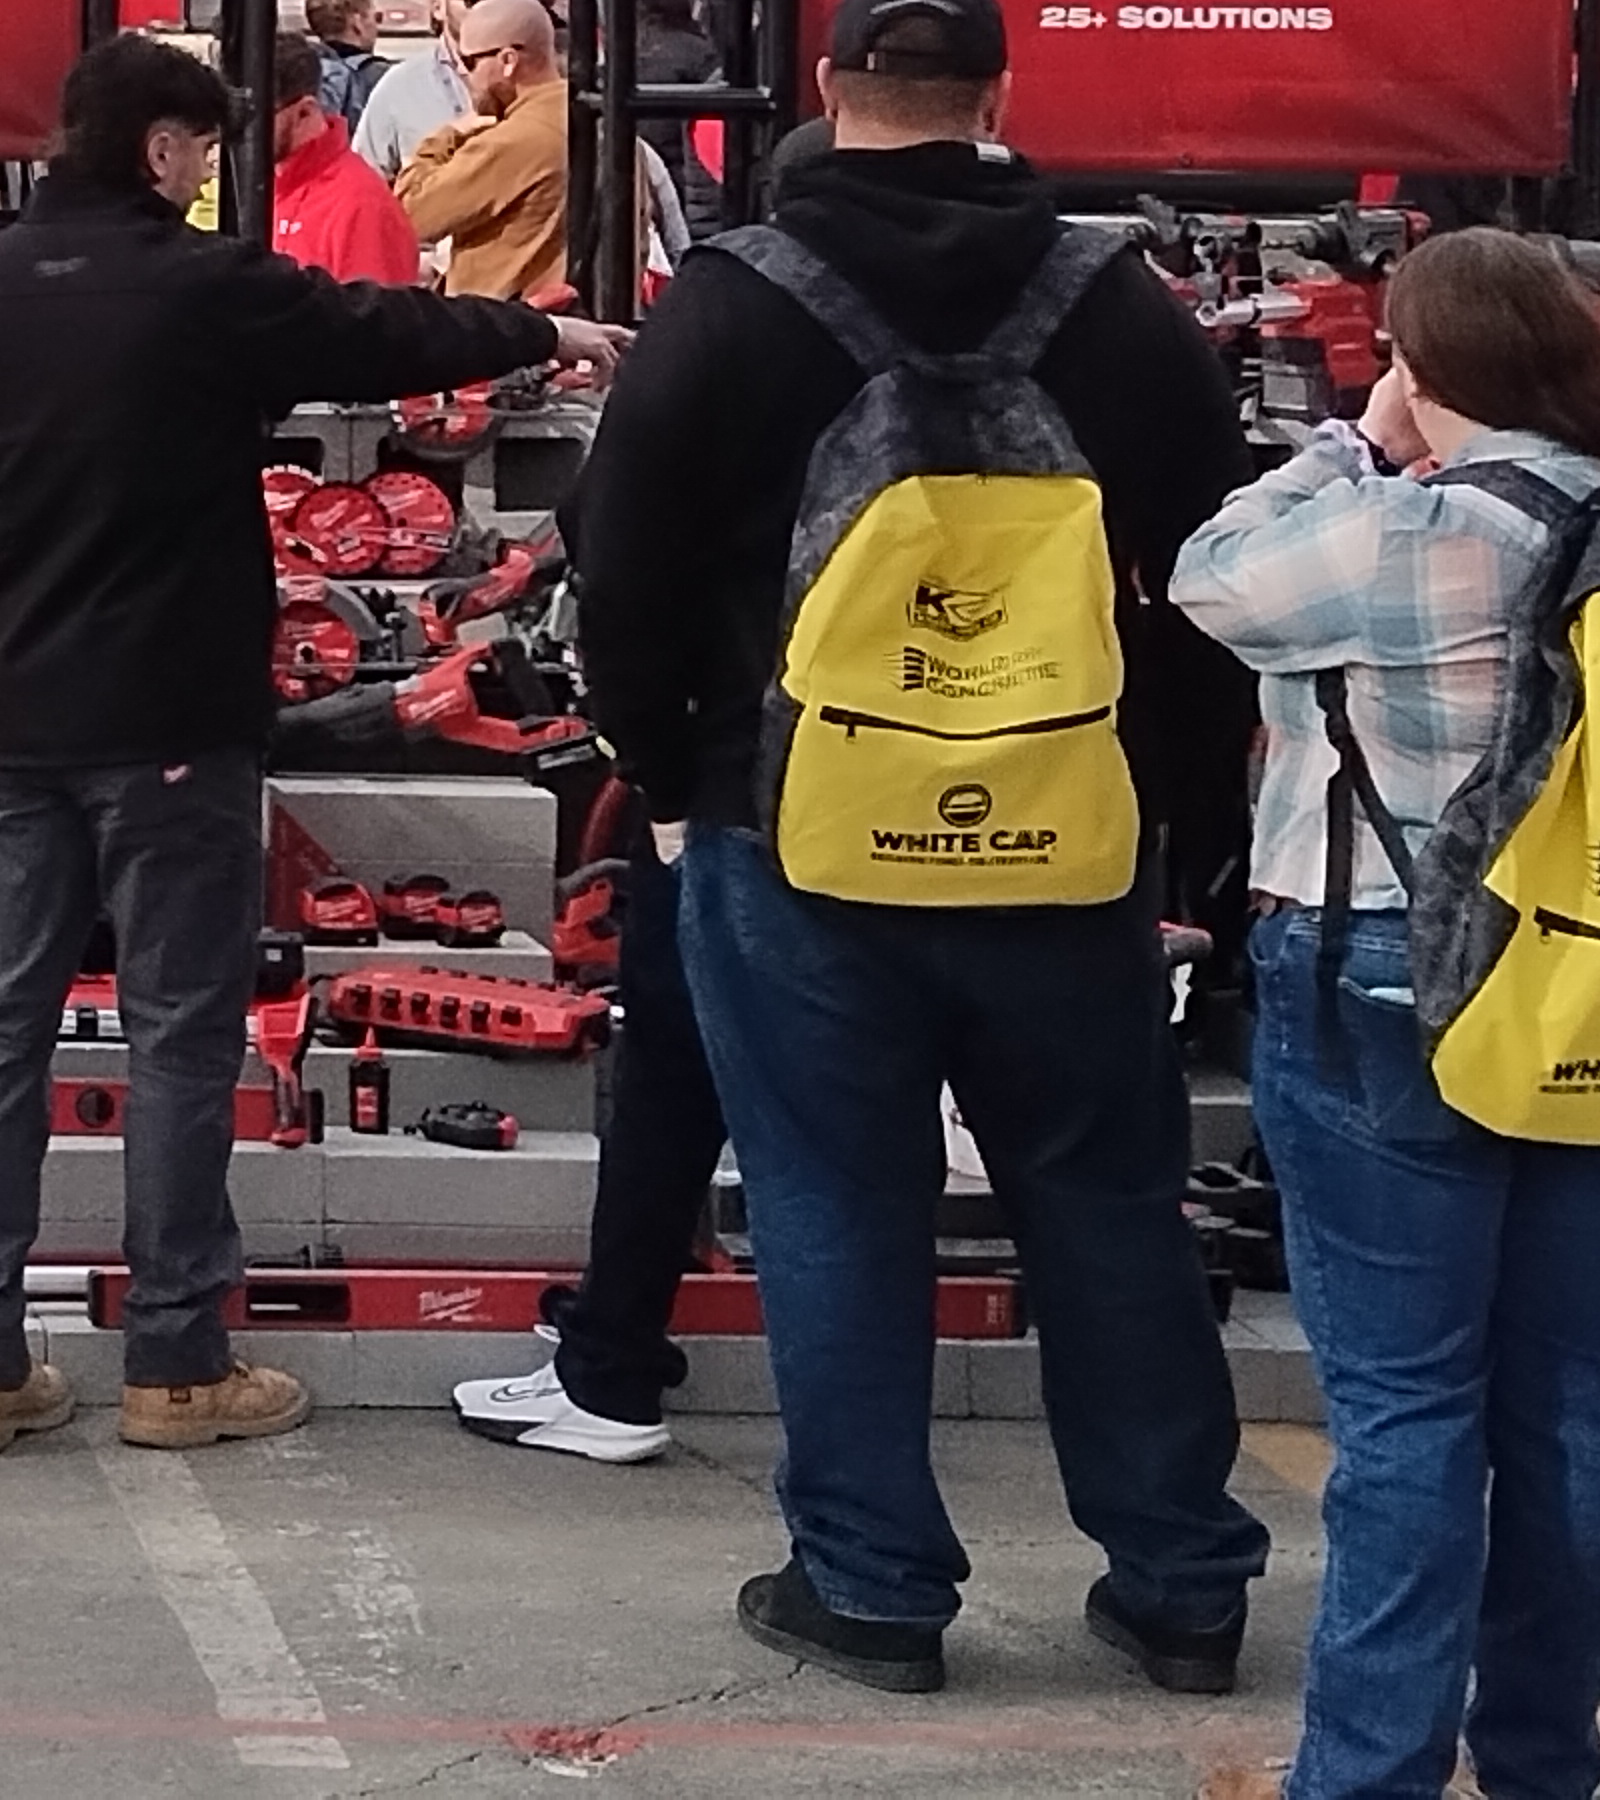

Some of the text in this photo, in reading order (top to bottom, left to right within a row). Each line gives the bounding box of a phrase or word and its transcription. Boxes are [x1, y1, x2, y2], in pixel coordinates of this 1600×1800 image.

[1040, 6, 1332, 29] 25+ SOLUTIONS
[871, 829, 1058, 853] WHITE CAP
